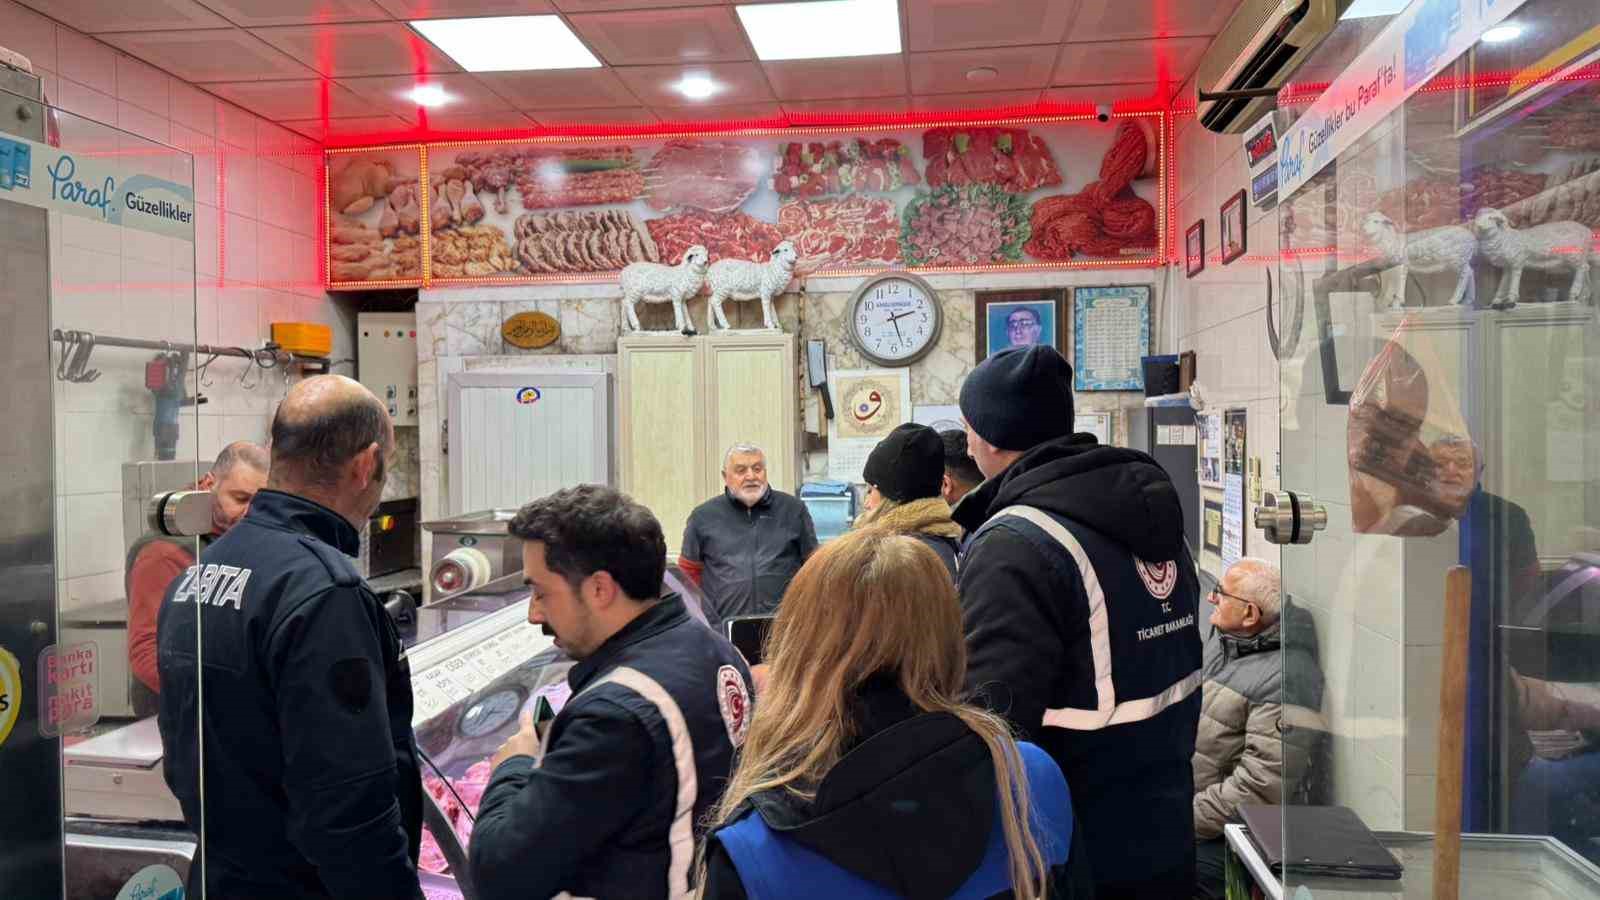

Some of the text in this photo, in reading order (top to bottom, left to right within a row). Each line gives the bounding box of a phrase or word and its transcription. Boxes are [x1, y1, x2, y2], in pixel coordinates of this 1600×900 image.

[1309, 110, 1344, 153] Güzellikler
[1345, 99, 1356, 120] bu
[126, 192, 192, 224] Güzellikler
[172, 564, 252, 610] ZABITA
